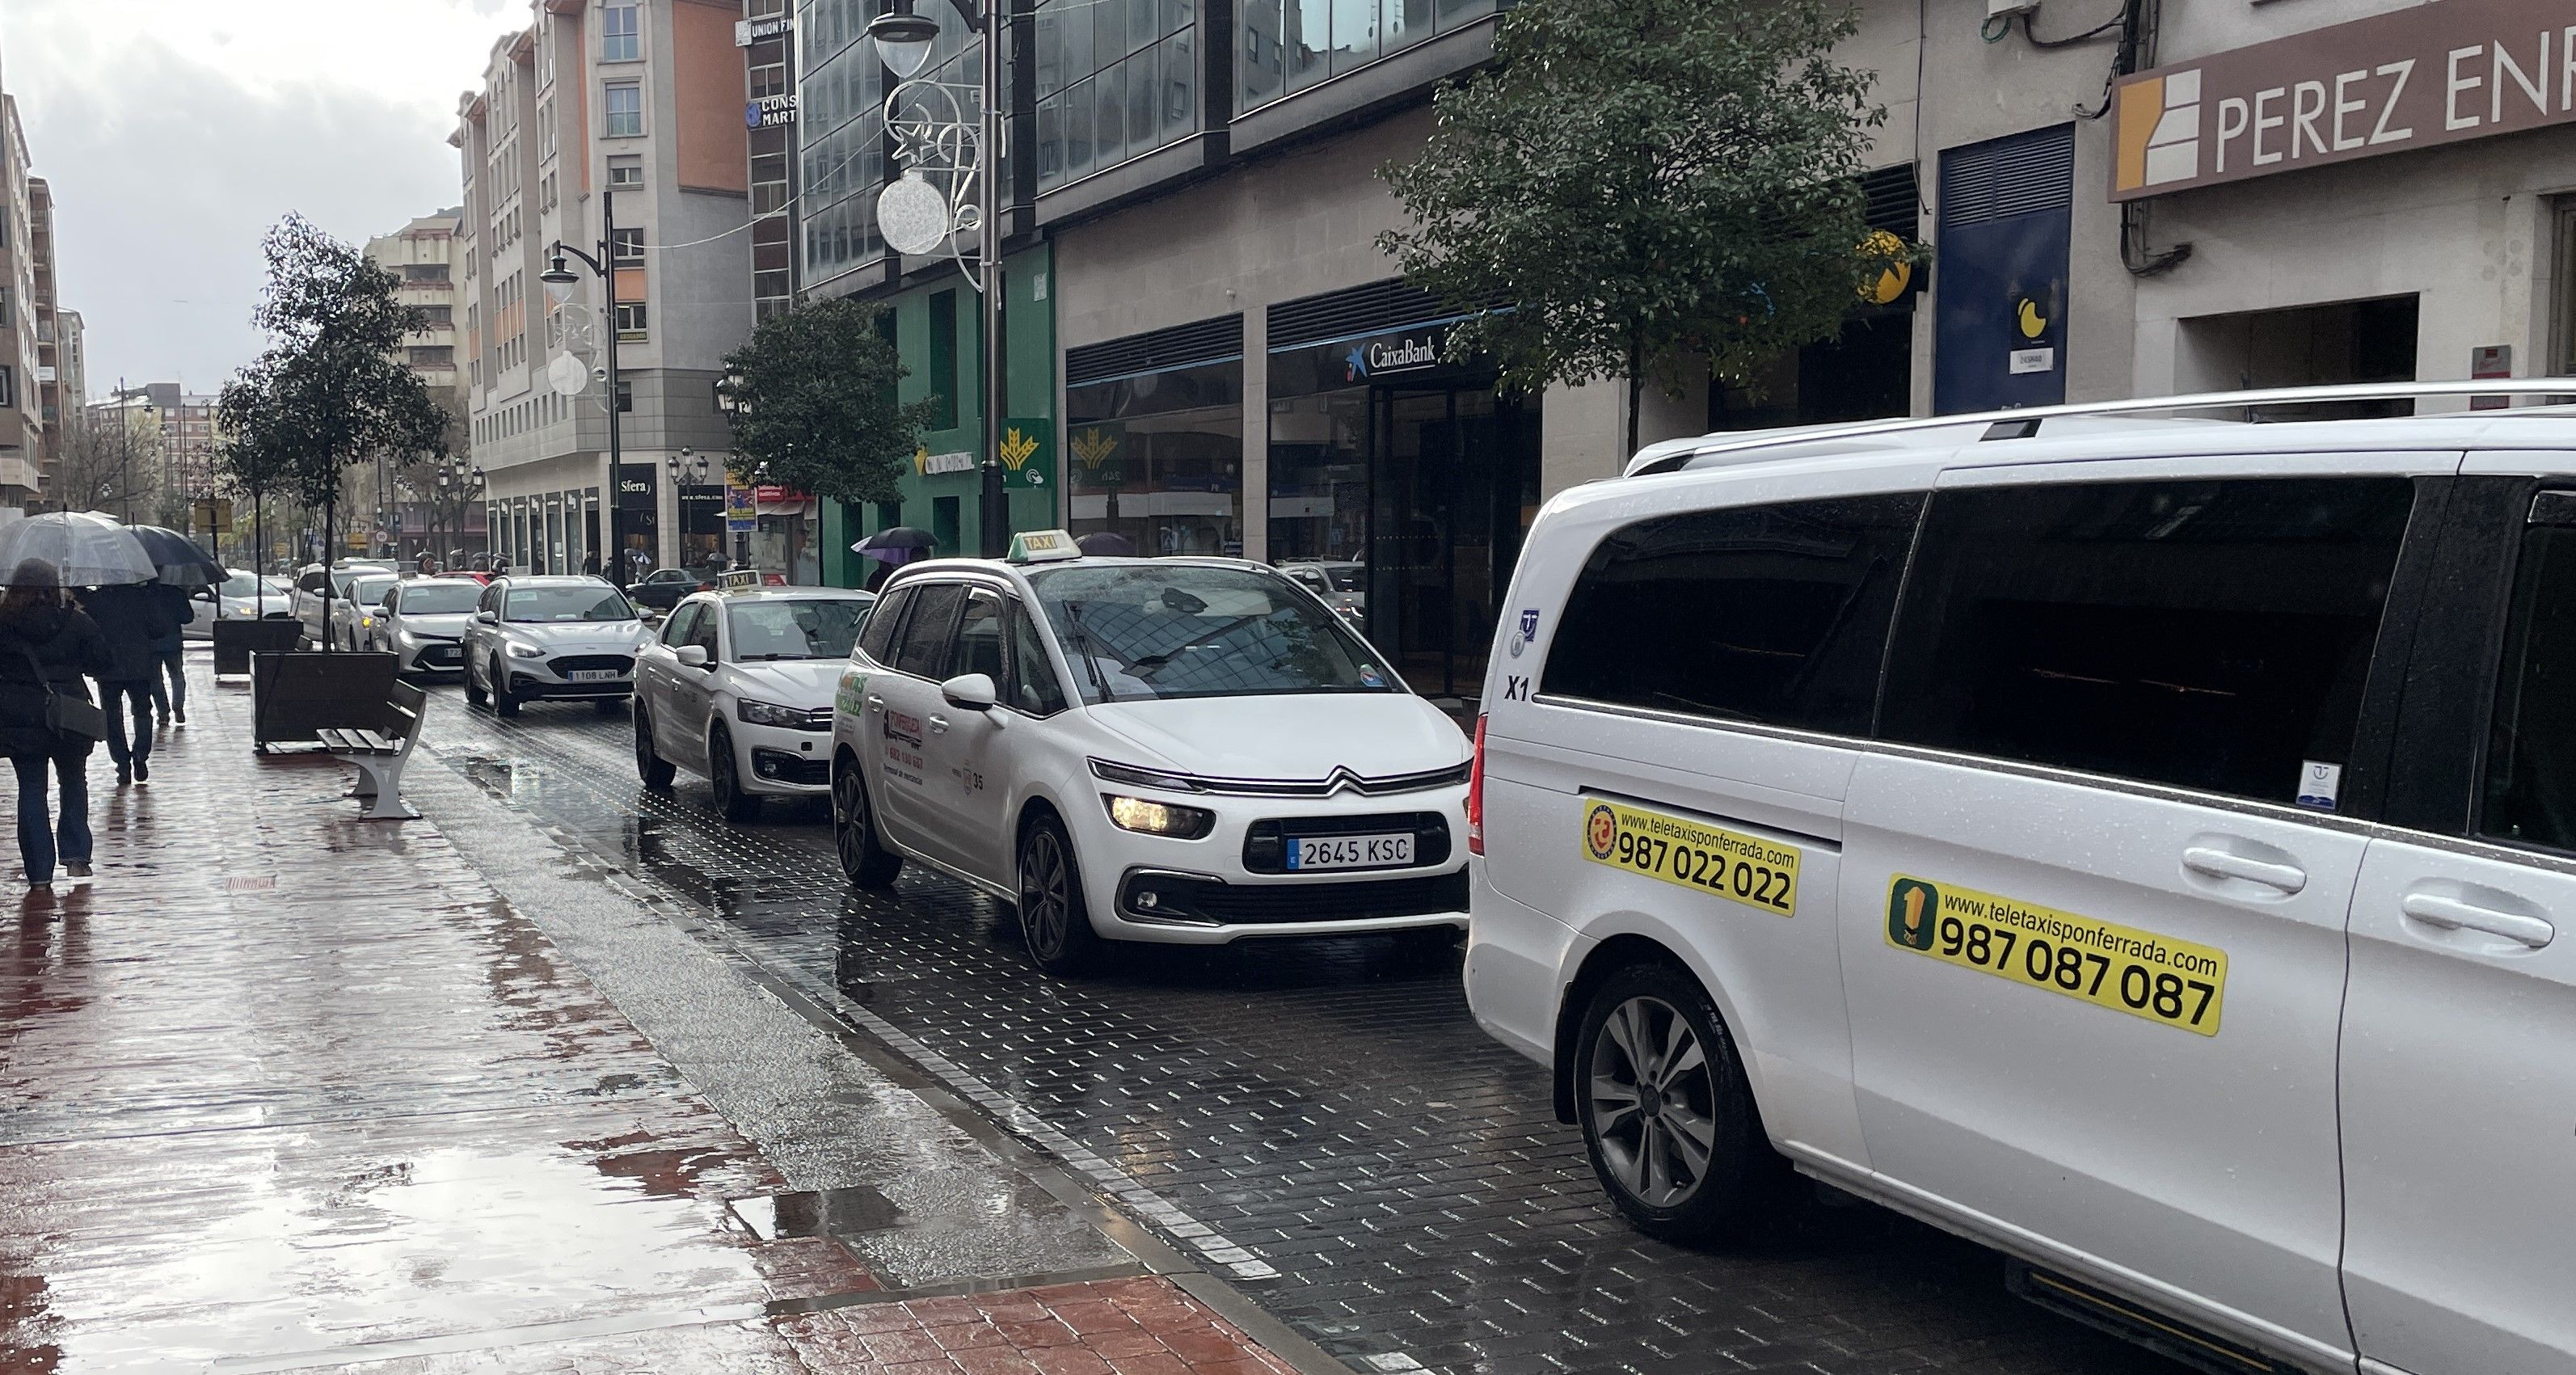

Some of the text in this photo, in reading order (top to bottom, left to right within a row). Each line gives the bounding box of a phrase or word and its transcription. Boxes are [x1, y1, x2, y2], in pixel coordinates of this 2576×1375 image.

[752, 21, 778, 38] UNION
[761, 95, 796, 112] CONS
[2216, 58, 2416, 173] PEREZ
[762, 109, 796, 127] MART
[1370, 335, 1436, 369] CaixaBank
[621, 479, 647, 492] Sfera
[1026, 535, 1056, 550] TAXI
[728, 573, 749, 587] TAXI
[1504, 675, 1529, 702] X1
[973, 772, 984, 791] 35
[1304, 838, 1408, 865] 2645 KSC
[1621, 812, 1794, 869] www.teletaxisponferrada.com
[1619, 831, 1668, 873] 987
[1673, 845, 1726, 891] 022
[1734, 862, 1790, 910] 022
[1944, 893, 2217, 977] www.teletaxisponferrada.com
[1941, 917, 2216, 1026] 987 087 087
